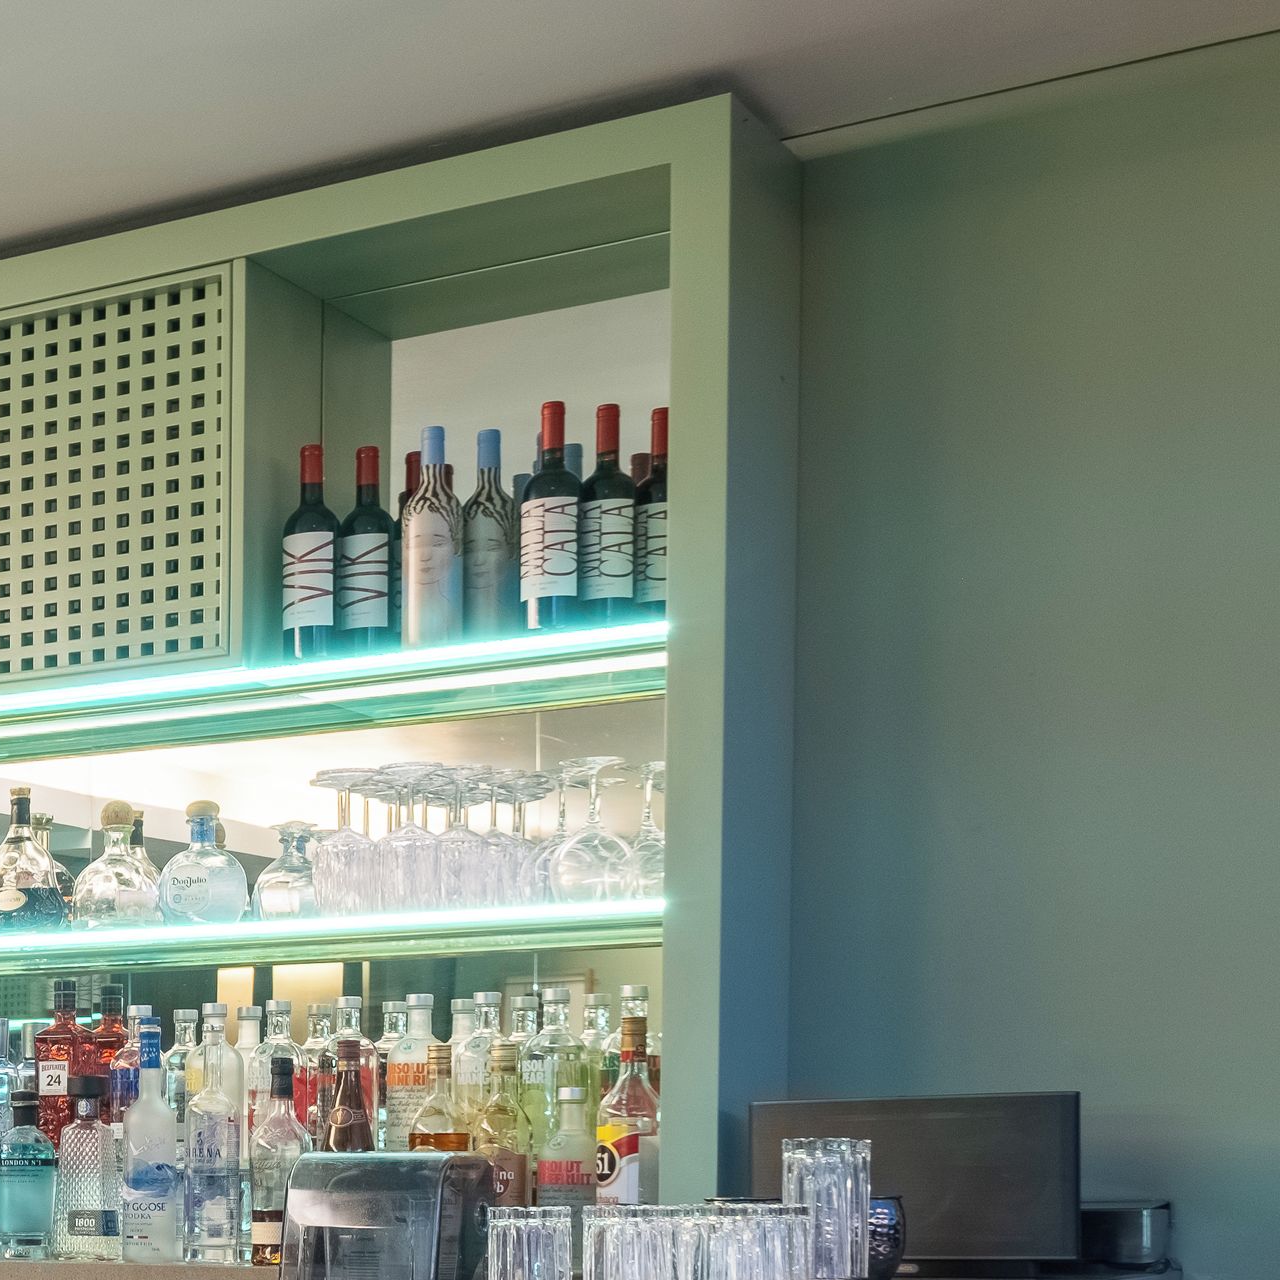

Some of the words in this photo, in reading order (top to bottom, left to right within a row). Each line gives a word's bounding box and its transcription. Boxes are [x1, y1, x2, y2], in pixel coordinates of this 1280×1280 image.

[46, 1074, 61, 1086] 24
[596, 1153, 611, 1174] 51
[132, 1203, 166, 1211] GOOSE
[75, 1219, 95, 1227] 1800
